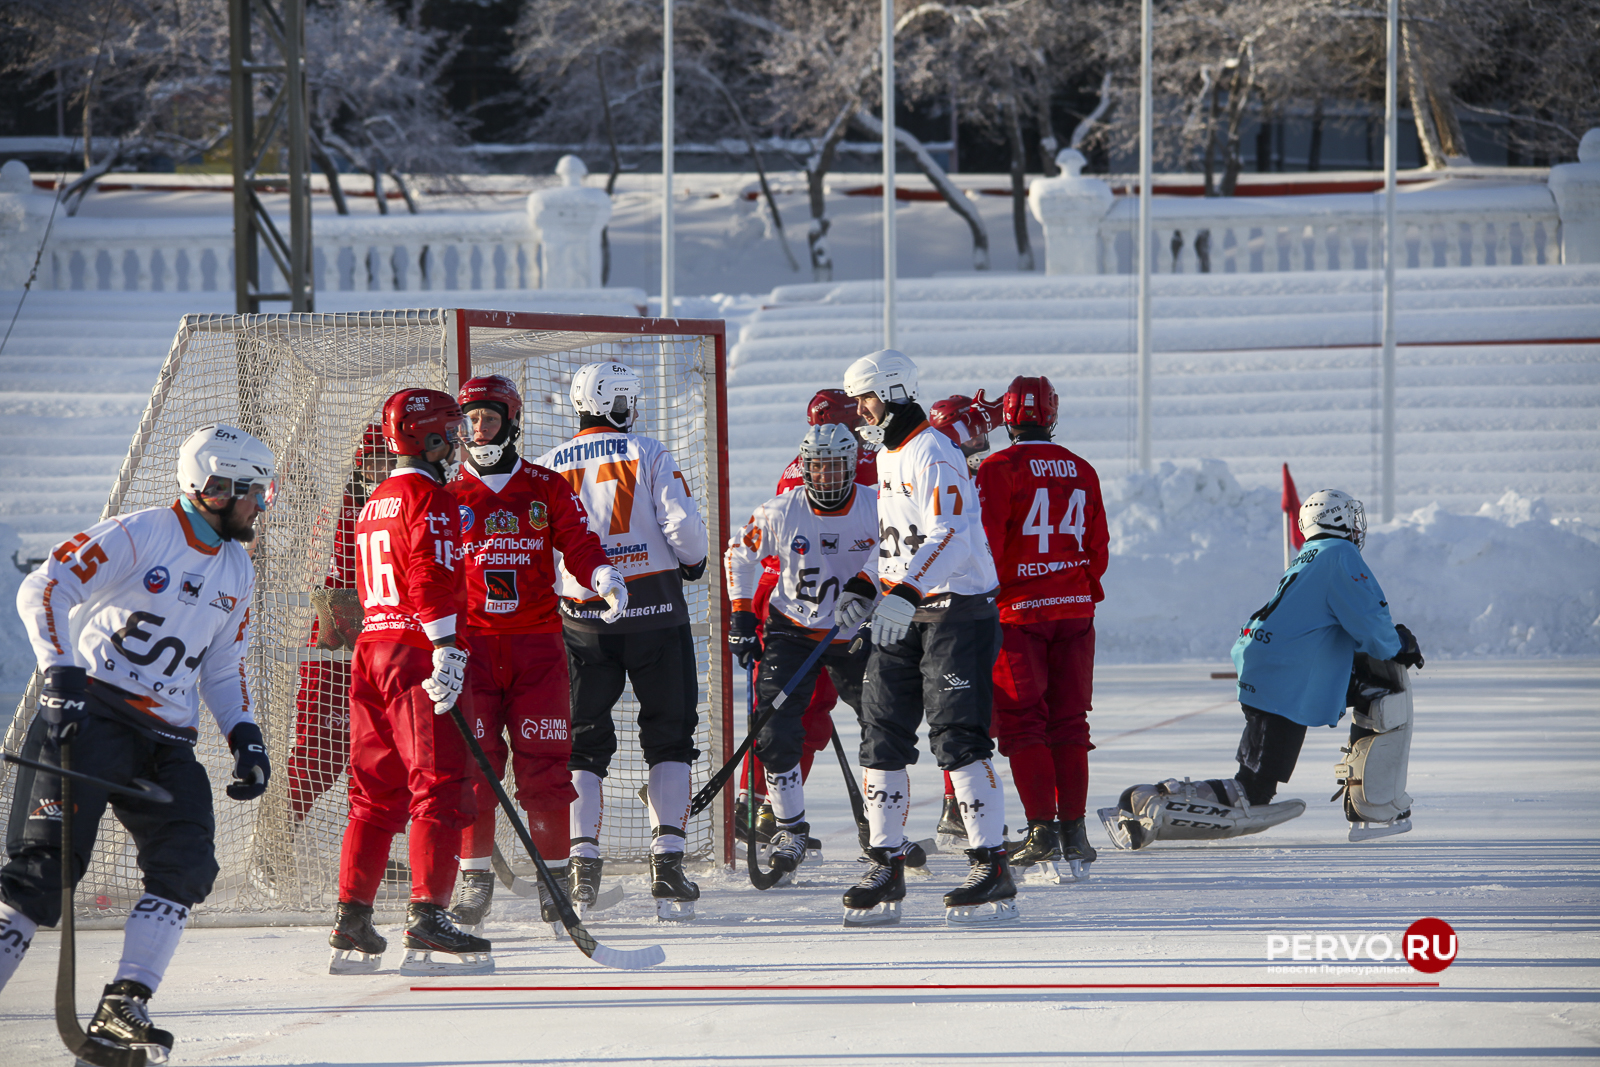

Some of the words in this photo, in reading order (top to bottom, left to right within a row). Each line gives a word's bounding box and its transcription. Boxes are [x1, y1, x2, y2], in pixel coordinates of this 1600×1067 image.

[553, 438, 628, 468] АНТИПОВ
[1029, 459, 1078, 478] ОРЛОВ
[1022, 488, 1086, 554] 44
[474, 553, 530, 567] ТРУБНИК
[357, 530, 400, 609] 16
[489, 584, 509, 599] ТМК
[487, 601, 517, 611] ПНТЗ
[1012, 596, 1076, 611] СВЕРДЛОВСКАЯ
[40, 693, 85, 710] CCM
[540, 718, 568, 730] SIMA
[540, 729, 568, 740] LAND
[1165, 801, 1231, 818] CCM
[1170, 818, 1232, 830] CCM
